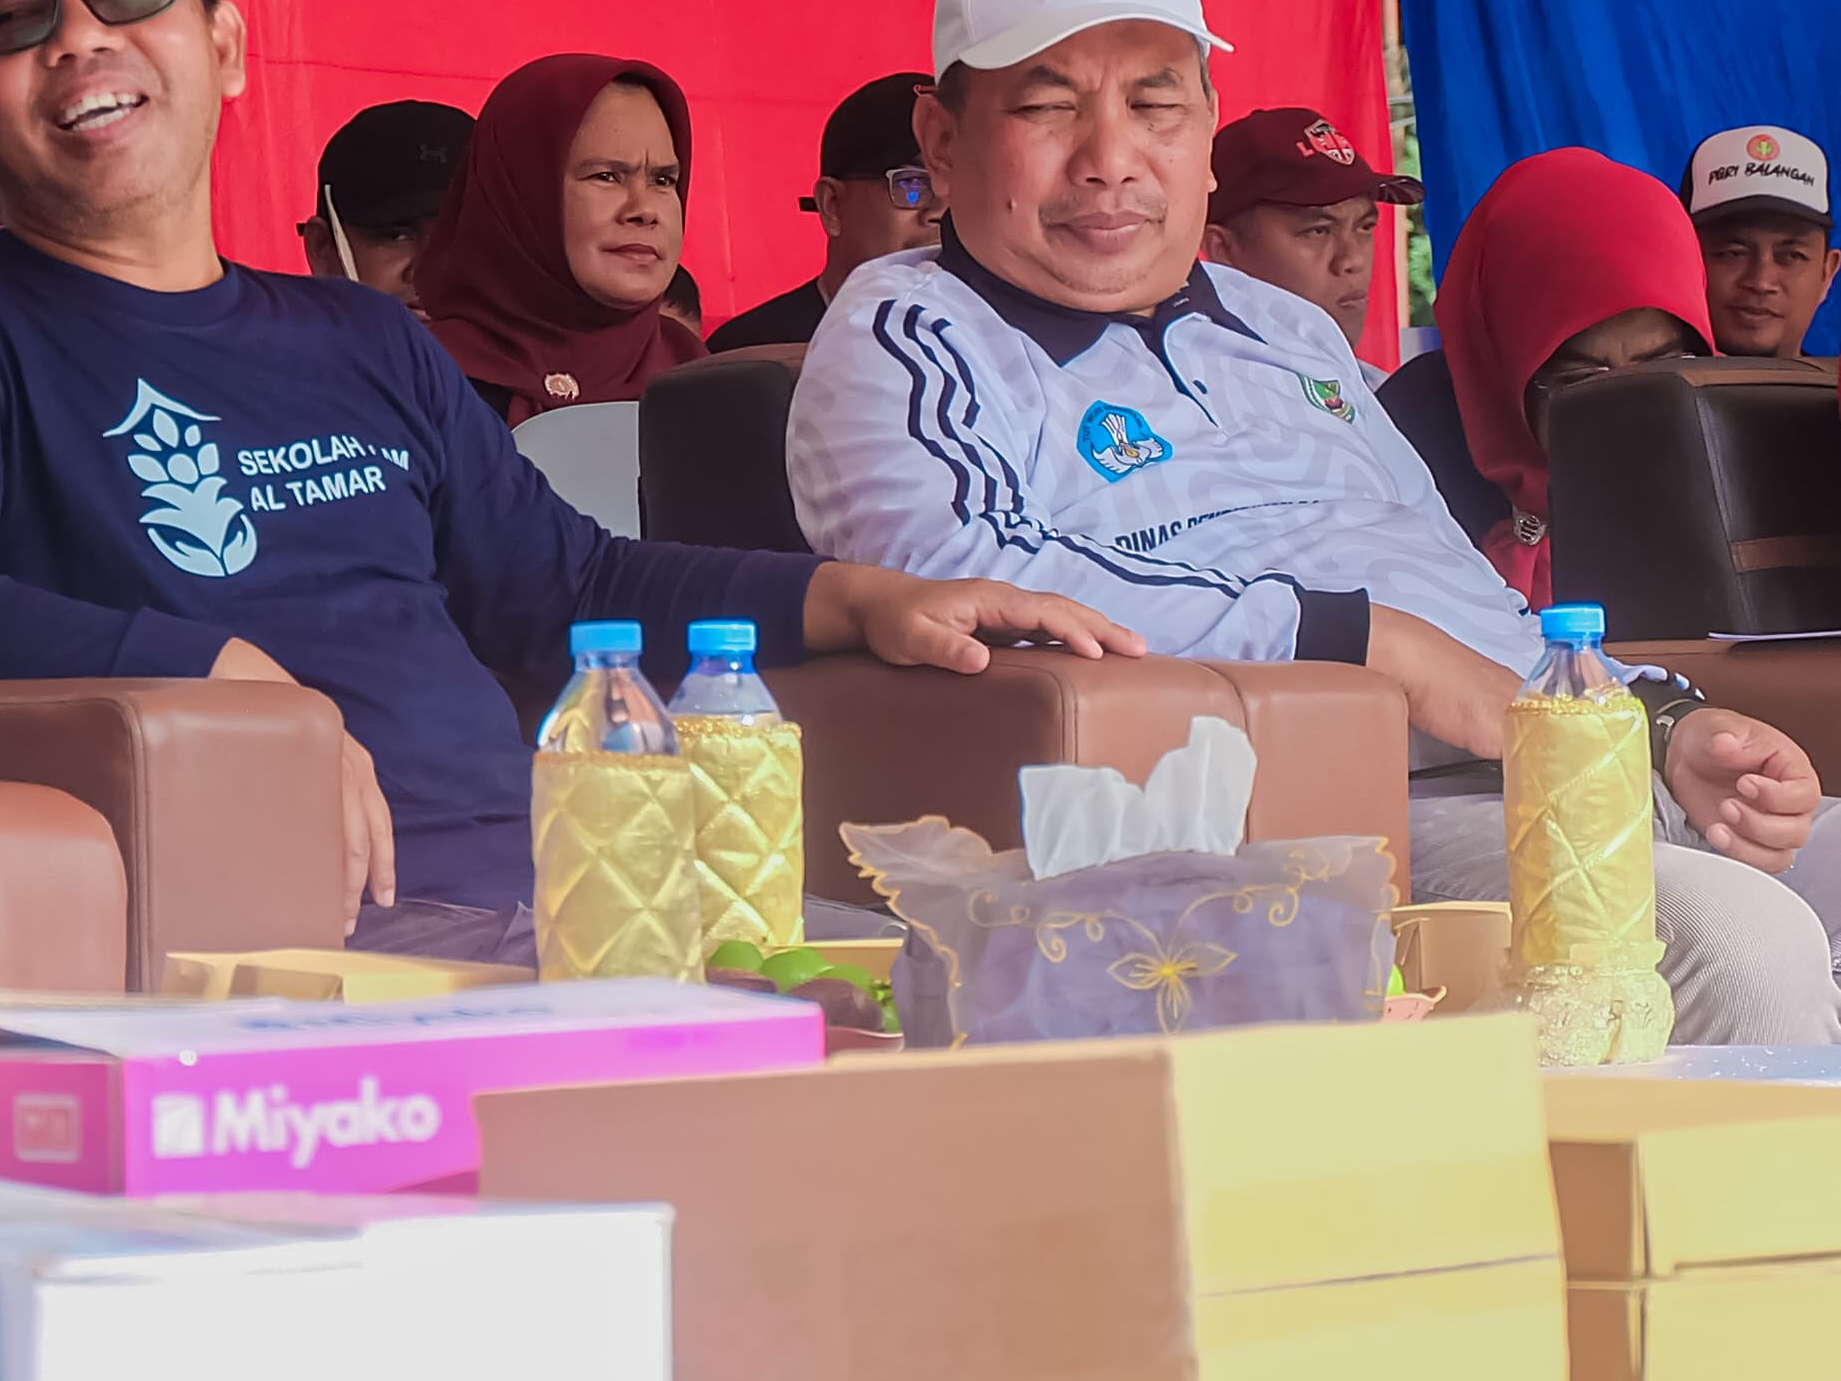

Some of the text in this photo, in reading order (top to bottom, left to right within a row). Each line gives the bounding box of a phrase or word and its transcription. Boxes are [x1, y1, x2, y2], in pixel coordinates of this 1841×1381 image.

[1708, 162, 1816, 188] PGRI BALANGAN
[237, 434, 367, 476] SEKOLAH
[250, 465, 387, 512] AL TAMAR
[212, 1075, 442, 1169] Miyako
